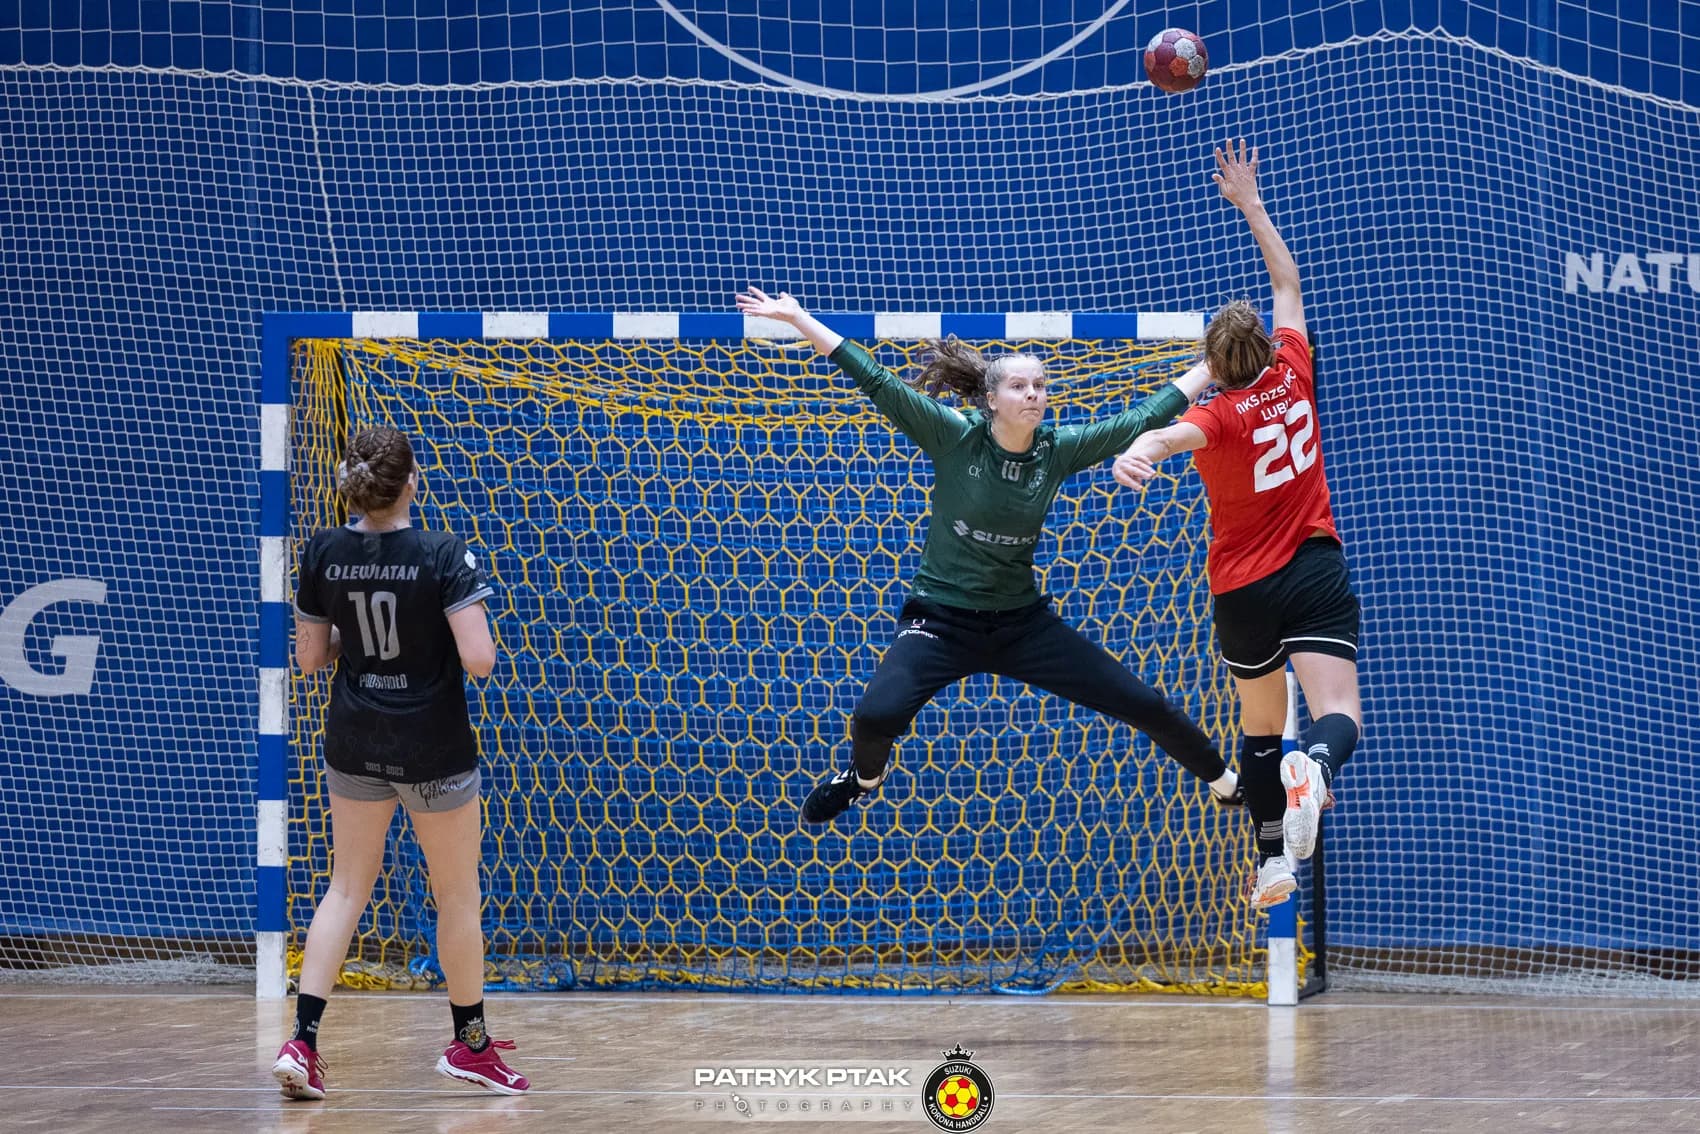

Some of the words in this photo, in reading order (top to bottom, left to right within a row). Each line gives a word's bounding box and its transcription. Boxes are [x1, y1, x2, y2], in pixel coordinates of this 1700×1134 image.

[1260, 384, 1287, 403] AZS
[1252, 399, 1318, 493] 22
[342, 563, 420, 581] LEWIATAN
[347, 591, 401, 661] 10
